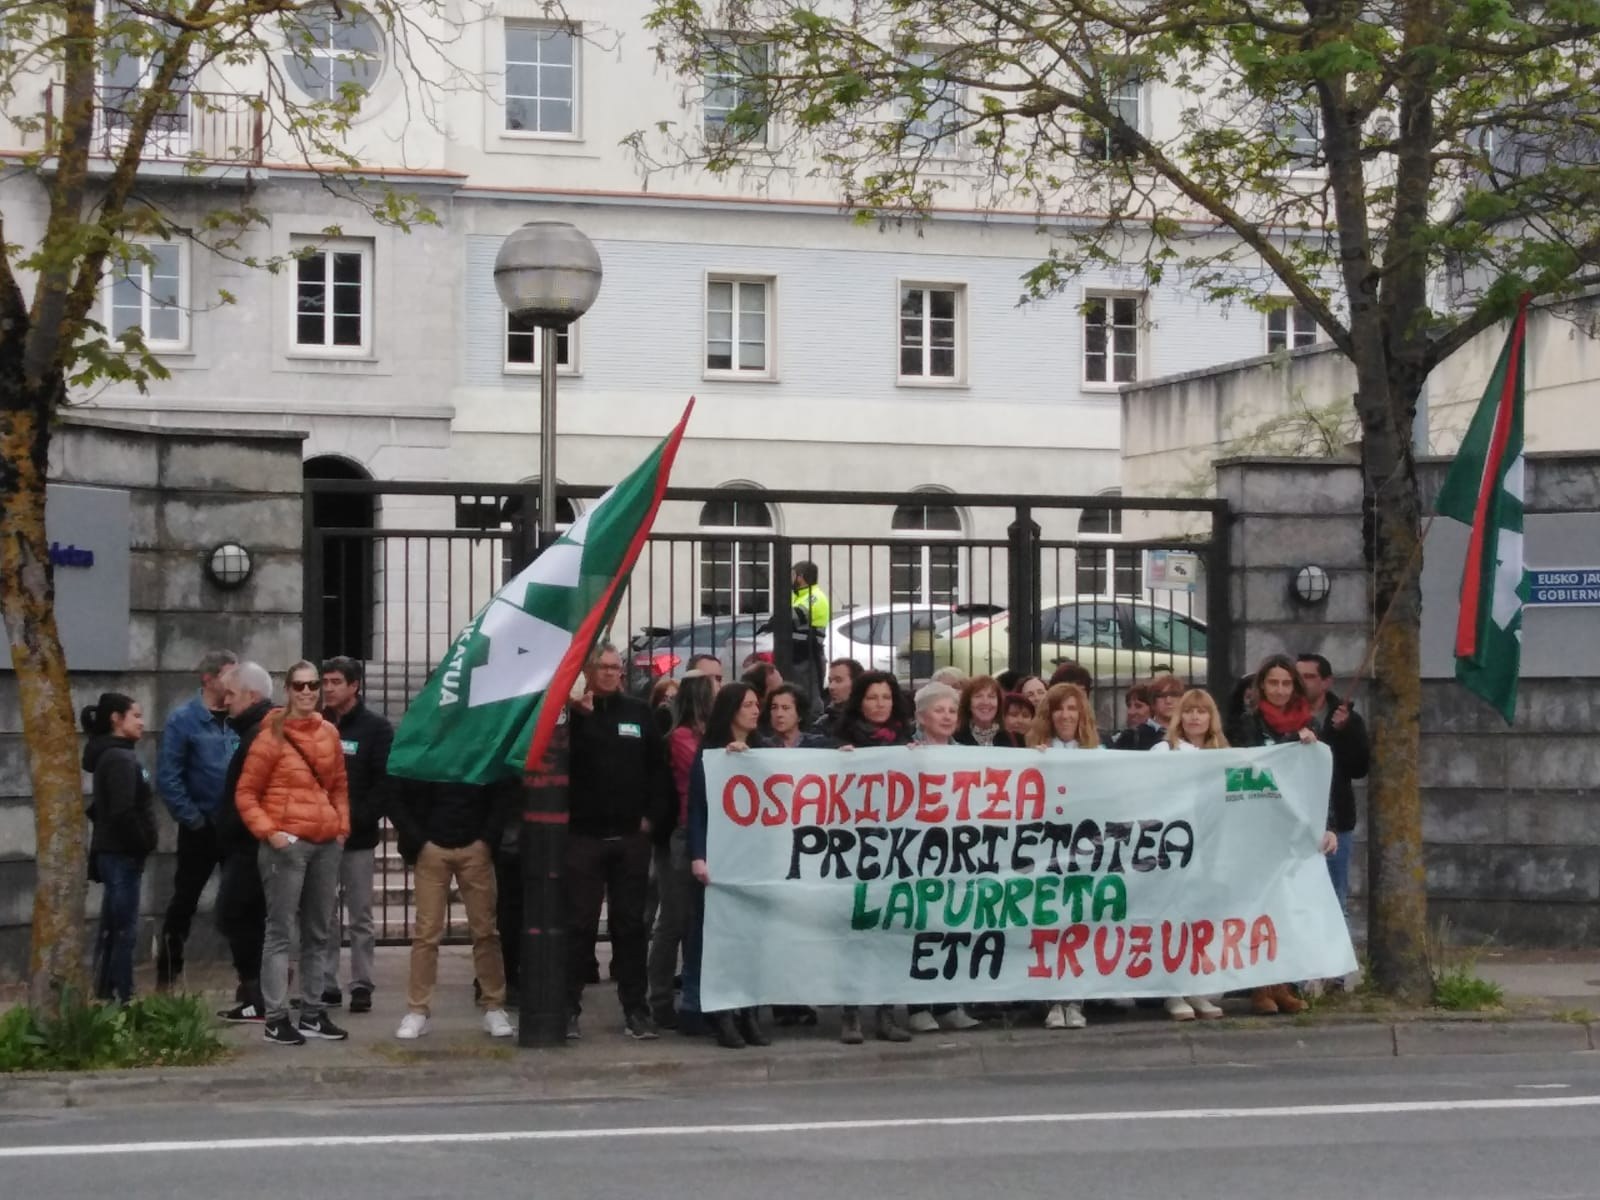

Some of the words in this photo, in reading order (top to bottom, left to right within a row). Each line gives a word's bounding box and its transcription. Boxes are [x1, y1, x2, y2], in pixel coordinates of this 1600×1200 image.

[1537, 573, 1579, 585] EUSKO
[1537, 588, 1600, 601] GOBIERN
[722, 766, 1067, 827] OSAKIDETZA:
[1224, 767, 1279, 792] ELA
[785, 819, 1194, 881] PREKARIETATEA
[851, 874, 1127, 931] LAPURRETA
[910, 930, 1006, 980] ETA
[1027, 914, 1278, 980] IRUZURRA
